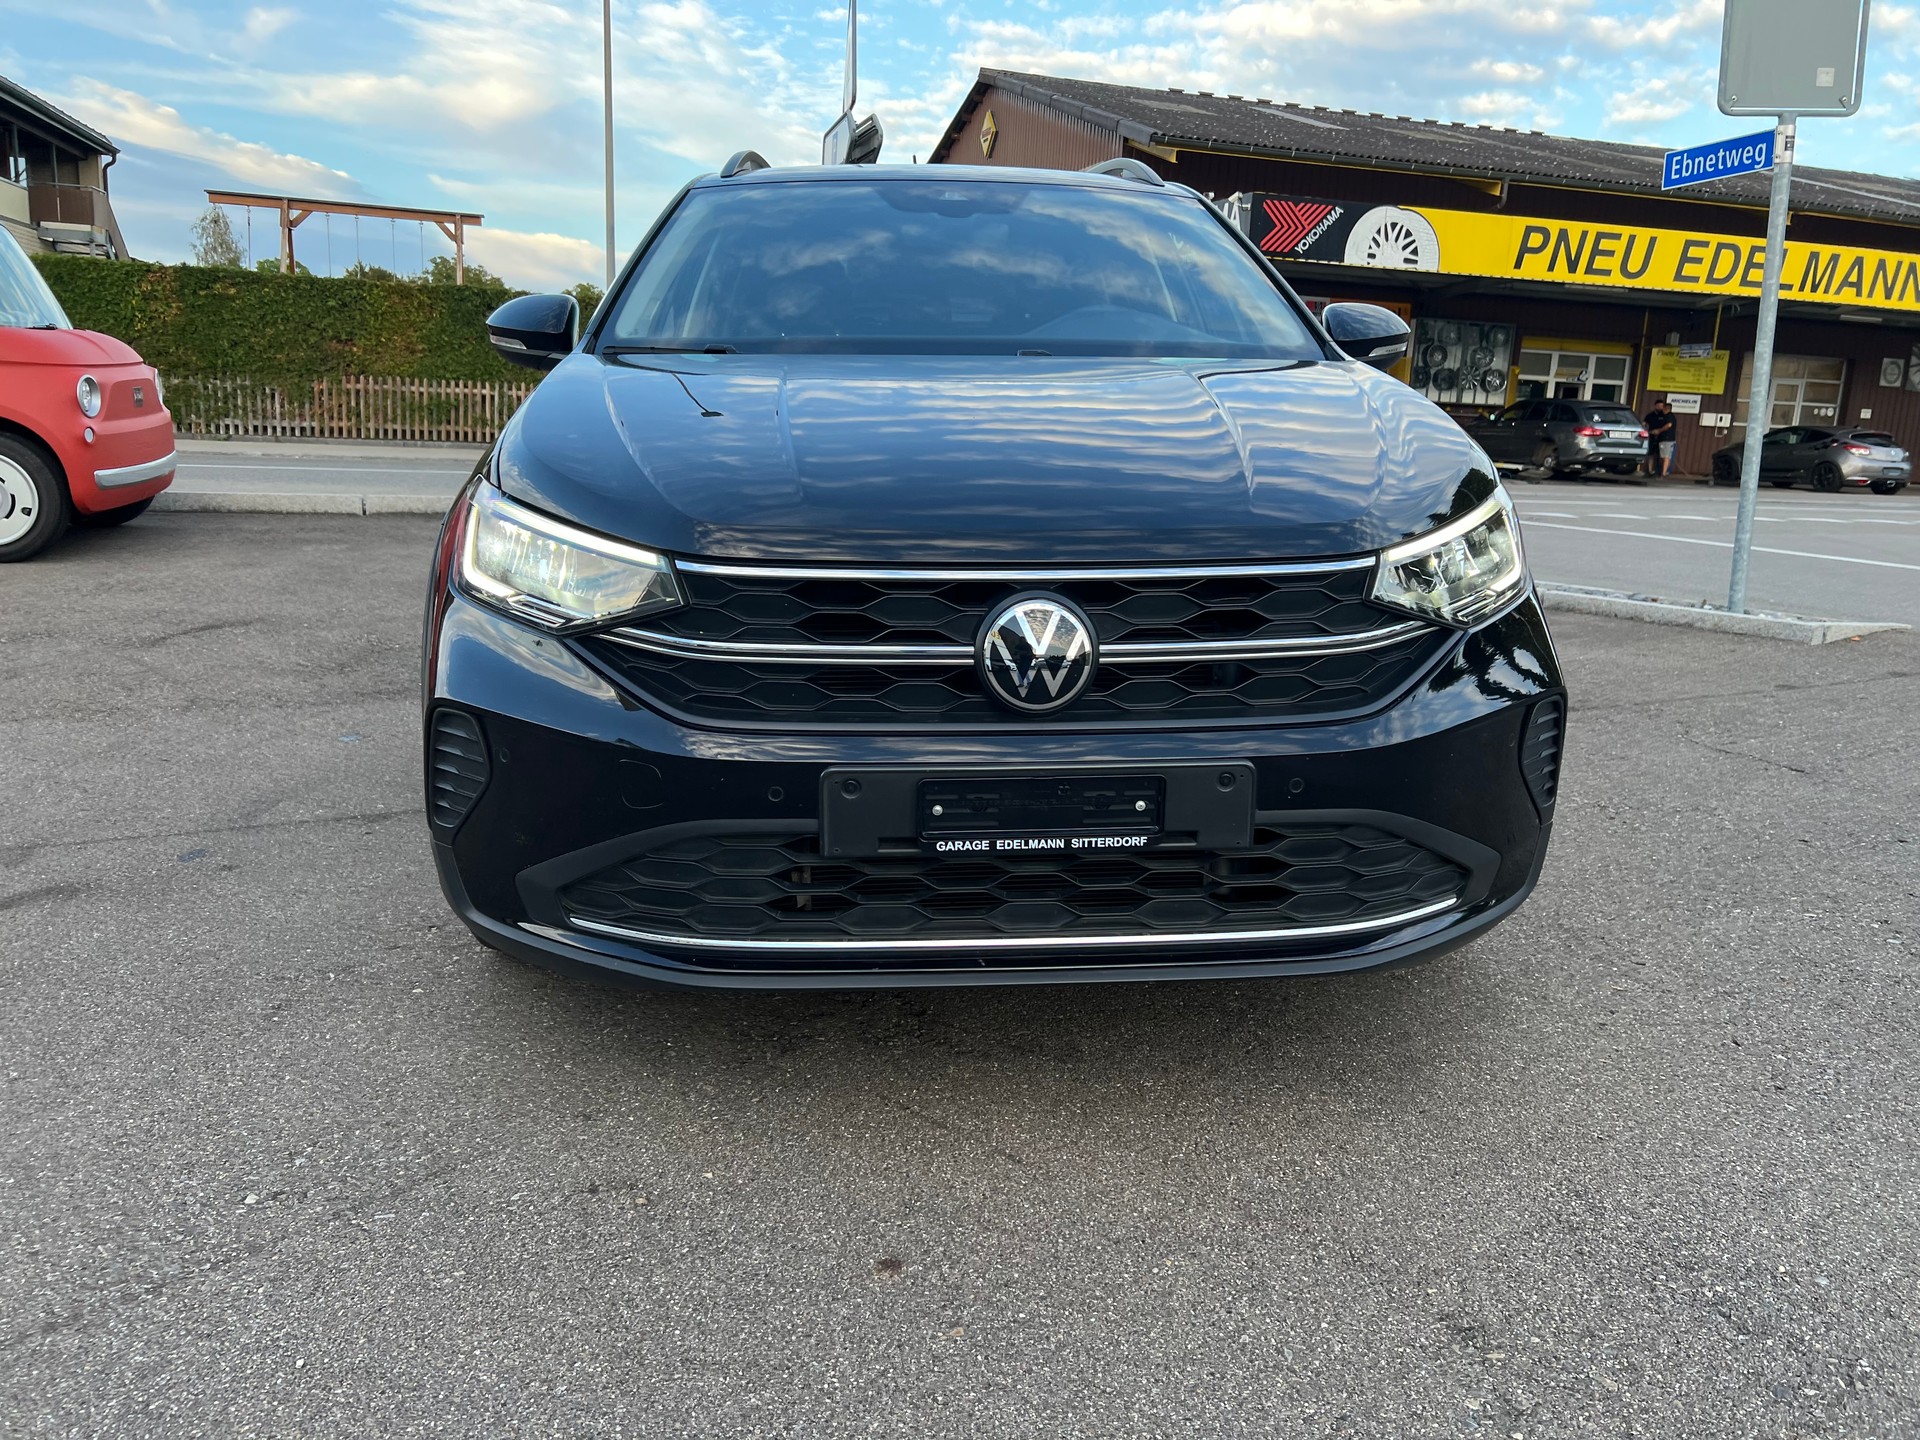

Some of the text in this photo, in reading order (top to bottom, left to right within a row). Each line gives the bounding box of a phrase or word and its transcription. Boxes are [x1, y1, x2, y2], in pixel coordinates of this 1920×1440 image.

[1671, 143, 1767, 180] Ebnetweg
[1294, 206, 1344, 254] YOKOHAMA
[1513, 225, 1658, 280] PNEU
[936, 836, 1148, 852] GARAGE EDELMANN SITTERDORF
